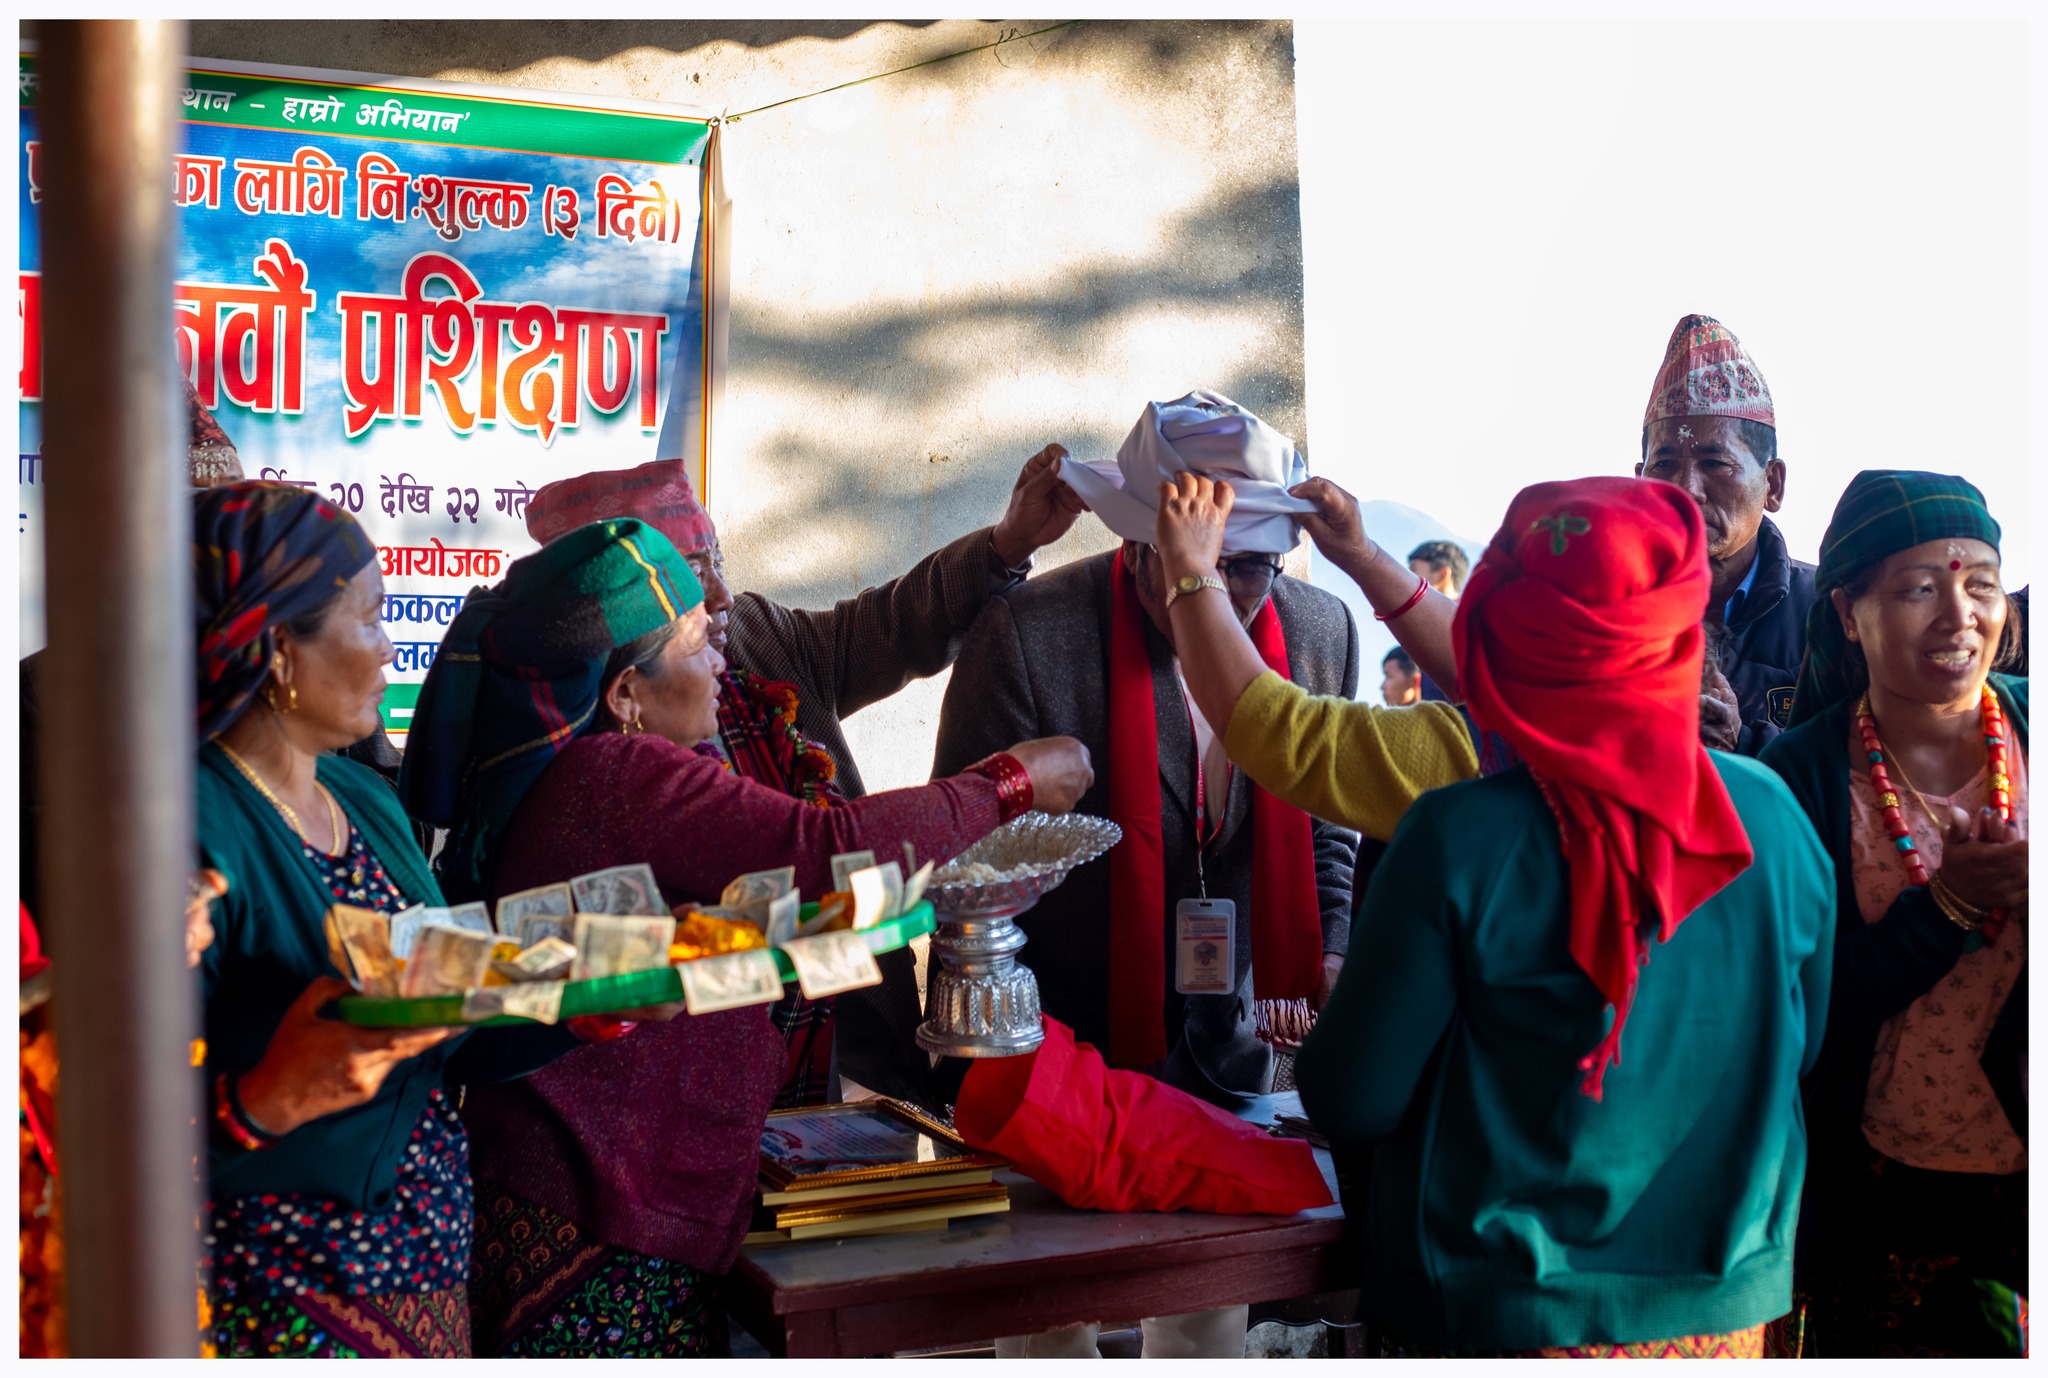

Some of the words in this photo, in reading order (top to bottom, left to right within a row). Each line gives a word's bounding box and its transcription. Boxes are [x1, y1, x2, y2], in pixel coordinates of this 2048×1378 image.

[282, 95, 345, 123] हाम्रो
[235, 147, 347, 217] लागि
[543, 185, 580, 240] (३
[596, 174, 681, 244] दिने)
[338, 253, 668, 445] प्रशिक्षण
[379, 472, 434, 518] देखि
[446, 487, 480, 524] २२
